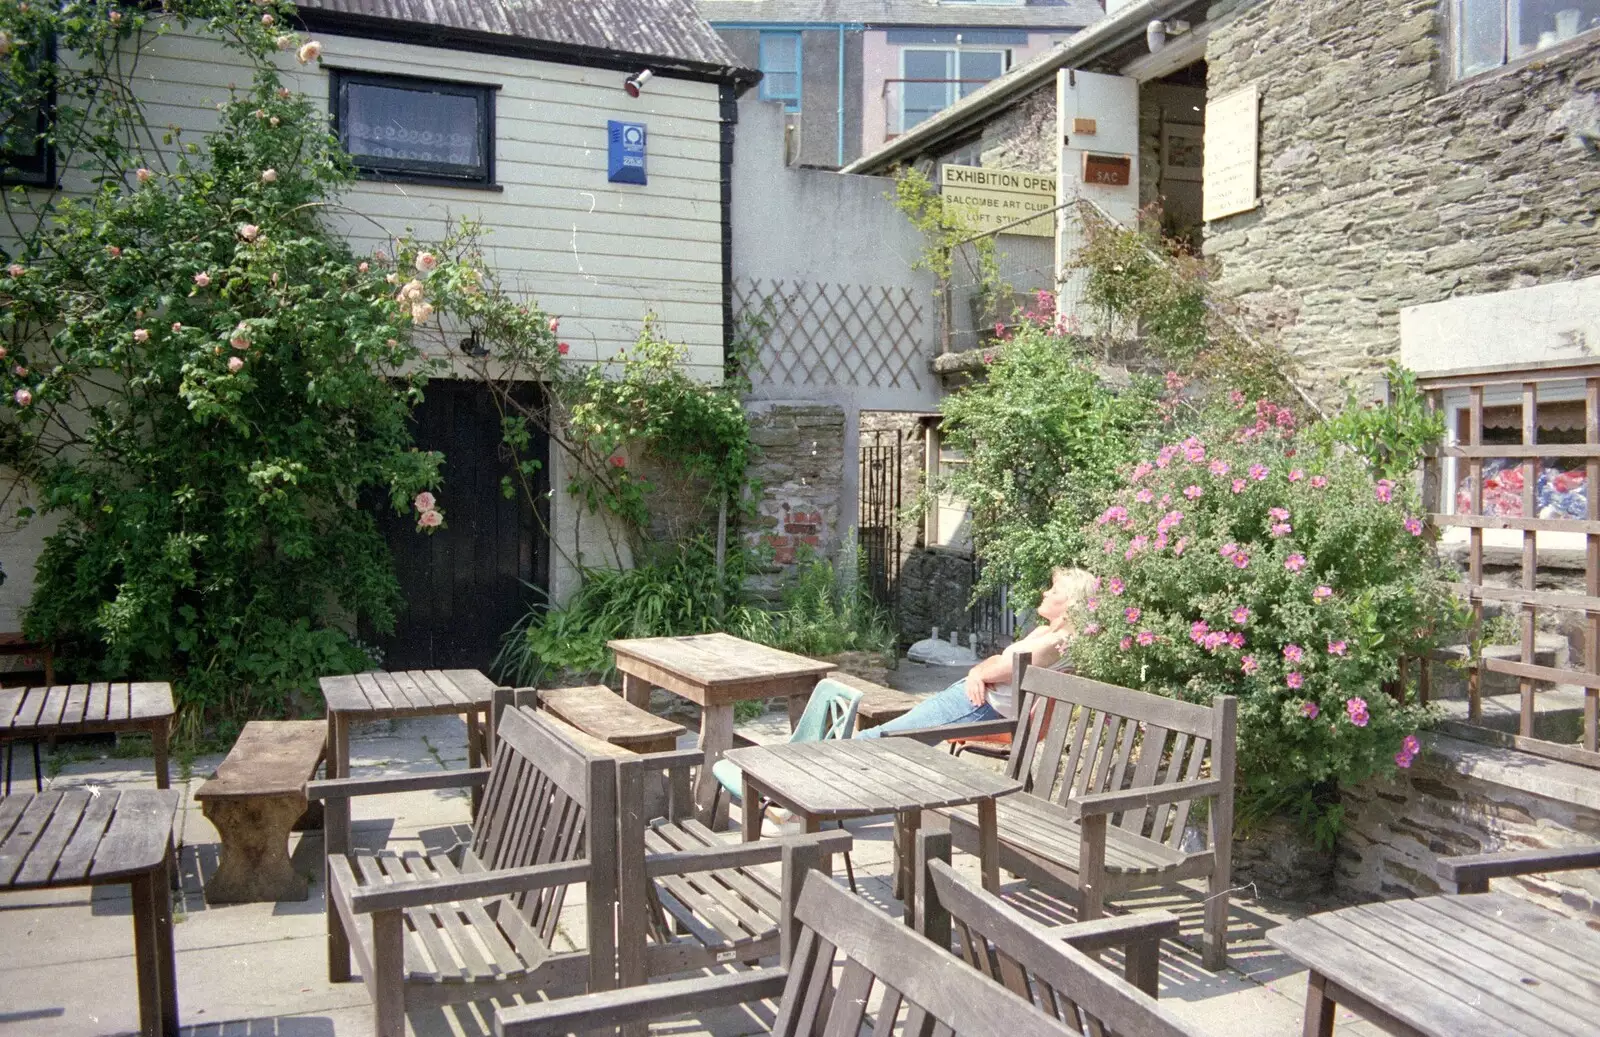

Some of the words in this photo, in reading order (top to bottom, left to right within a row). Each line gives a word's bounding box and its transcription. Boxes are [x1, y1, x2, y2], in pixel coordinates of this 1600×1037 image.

[946, 168, 1019, 189] EXHIBITION
[1023, 177, 1056, 192] OPEN
[1096, 171, 1118, 183] SAC
[946, 195, 999, 208] SALCOMBE
[1002, 200, 1021, 210] ART
